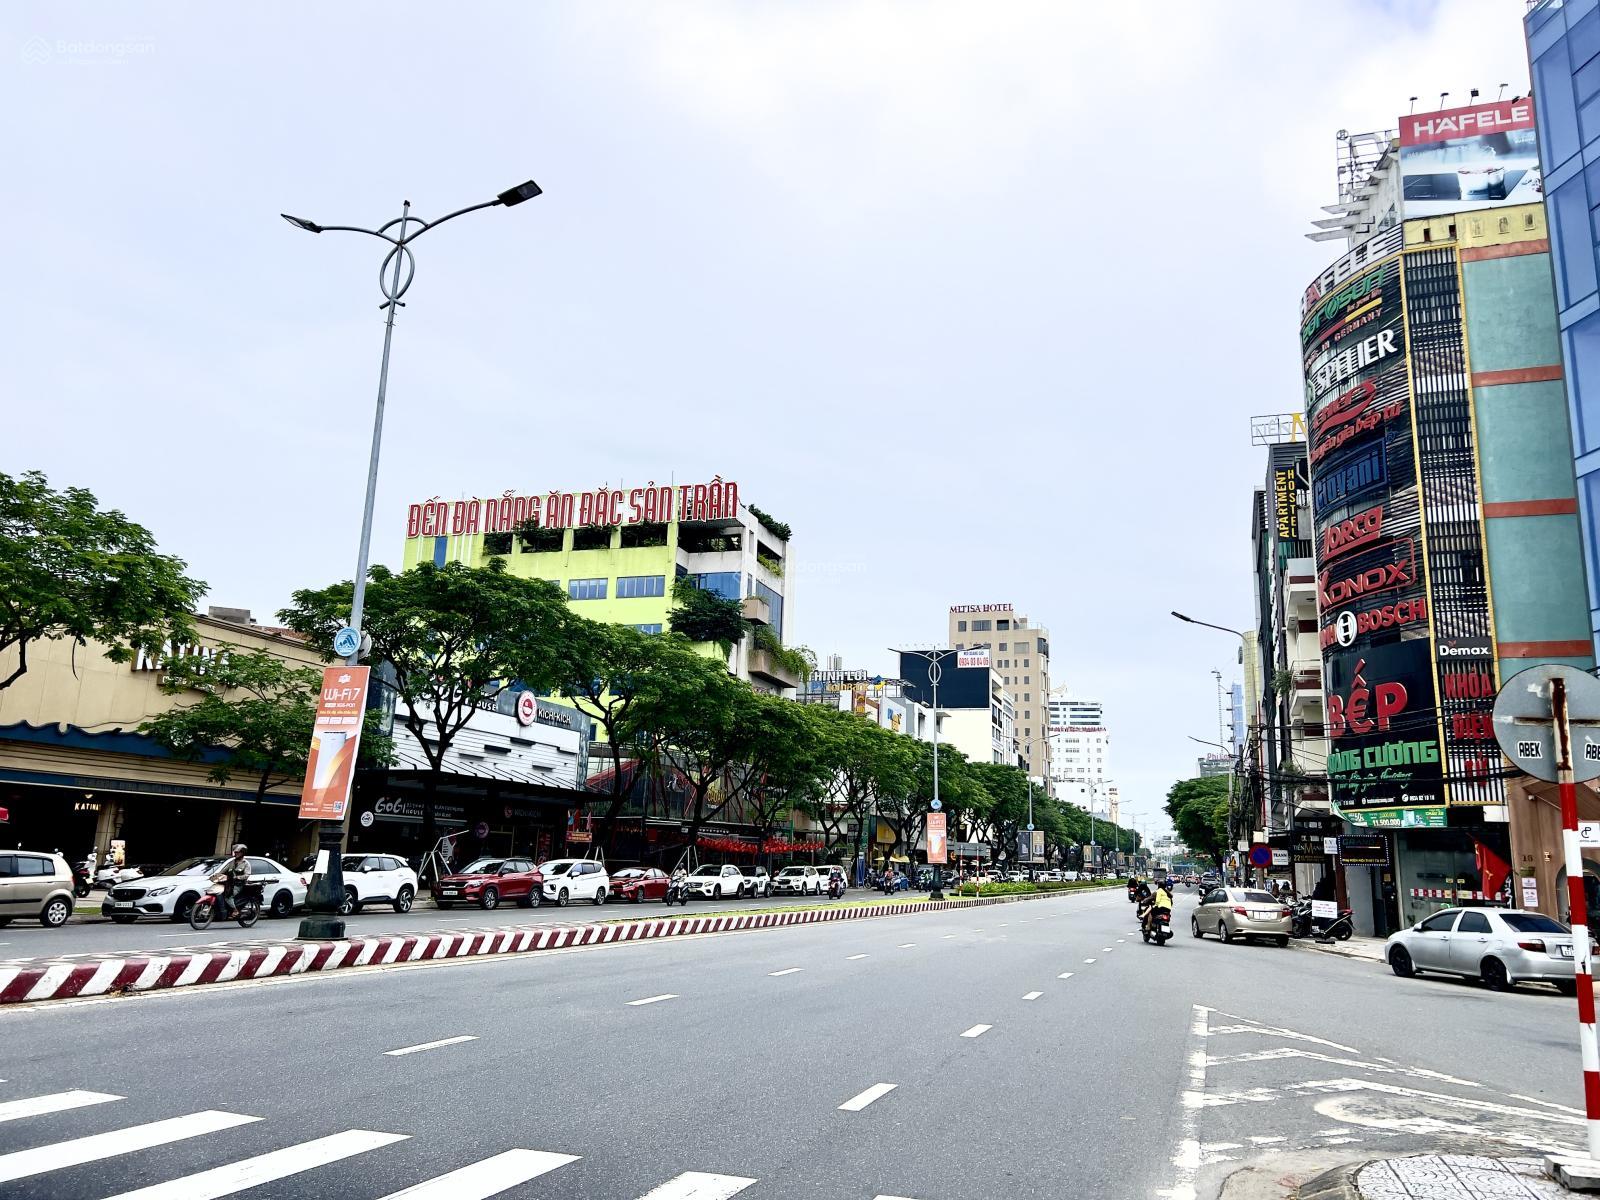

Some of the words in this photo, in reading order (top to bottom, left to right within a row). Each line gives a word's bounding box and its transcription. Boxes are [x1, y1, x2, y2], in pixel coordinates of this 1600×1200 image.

[1414, 105, 1530, 137] HÄFELE
[1334, 308, 1382, 341] GERMANY
[407, 495, 449, 539] ĐẾN
[452, 496, 481, 536] ĐÀ
[545, 490, 575, 529] ĂN
[679, 474, 738, 523] TRẦN
[1276, 471, 1289, 538] APARTMENT
[1288, 469, 1297, 537] HOSTEL
[950, 605, 981, 614] MITISA
[983, 603, 1014, 613] HOTEL
[1357, 597, 1427, 634] BOSCH
[352, 688, 361, 700] 7
[1328, 659, 1408, 739] BẾP
